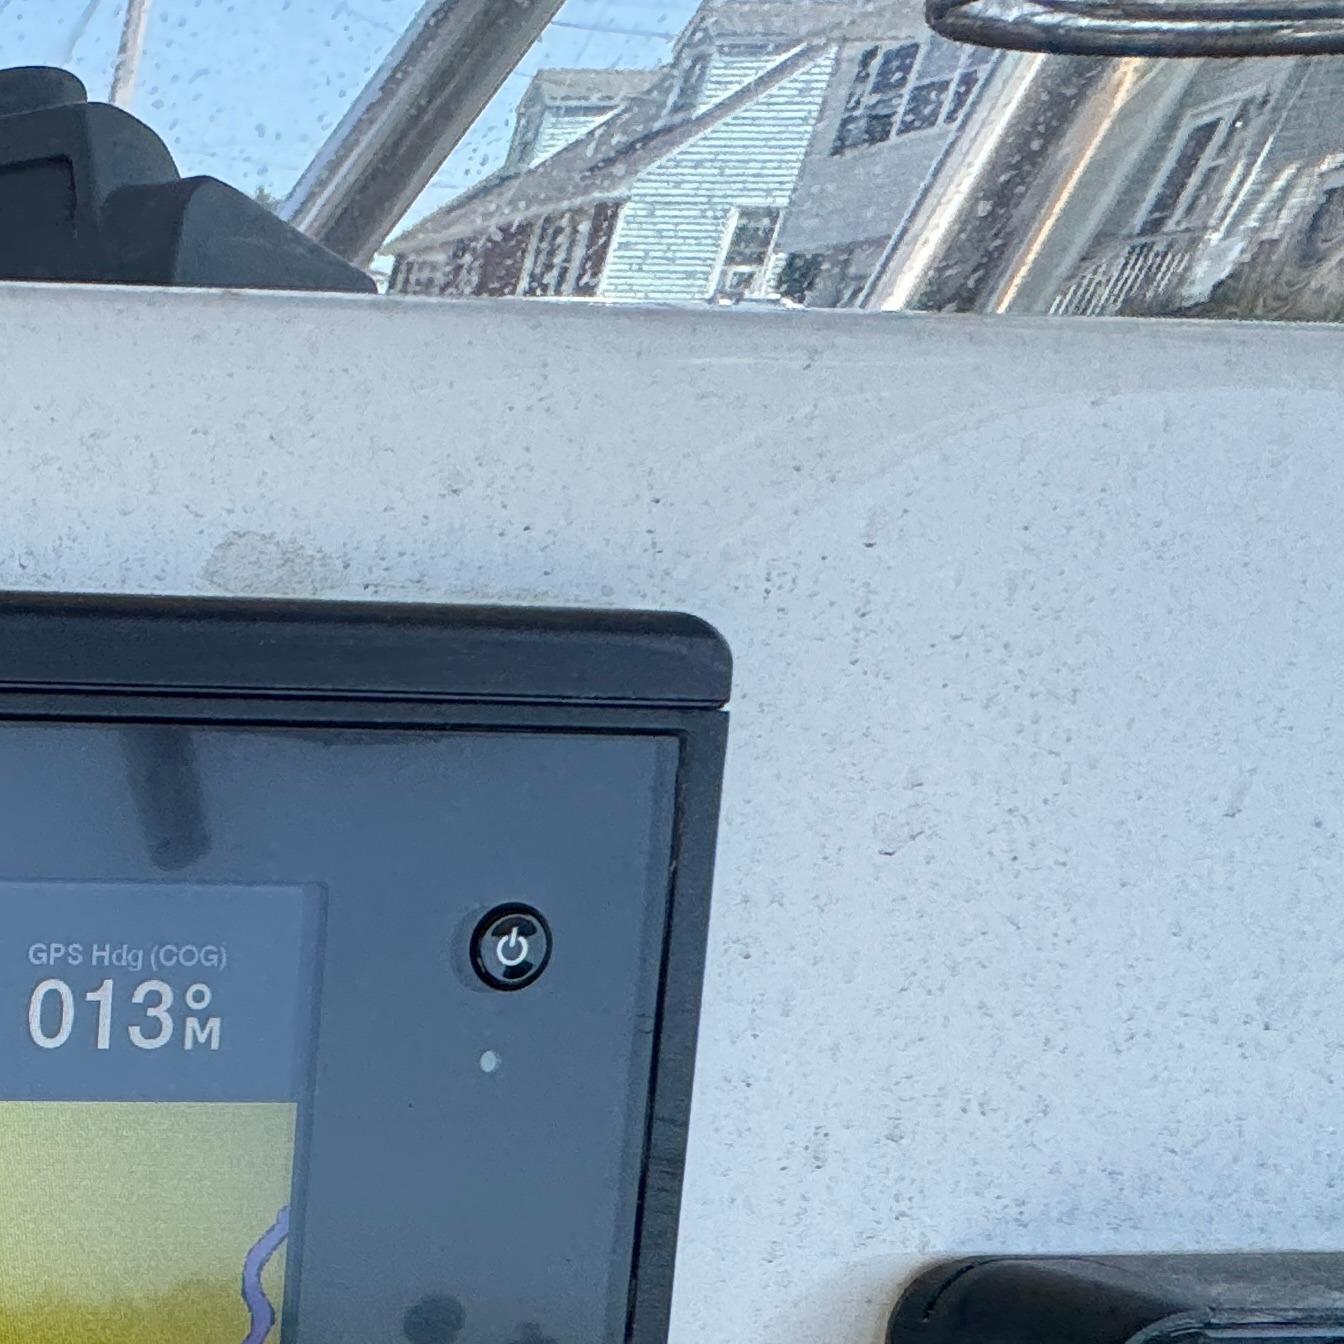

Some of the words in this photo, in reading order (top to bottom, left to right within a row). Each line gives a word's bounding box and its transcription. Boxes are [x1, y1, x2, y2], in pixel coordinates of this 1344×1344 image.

[28, 943, 84, 967] GPS
[91, 943, 144, 971] Hdg
[150, 943, 228, 972] (COG)
